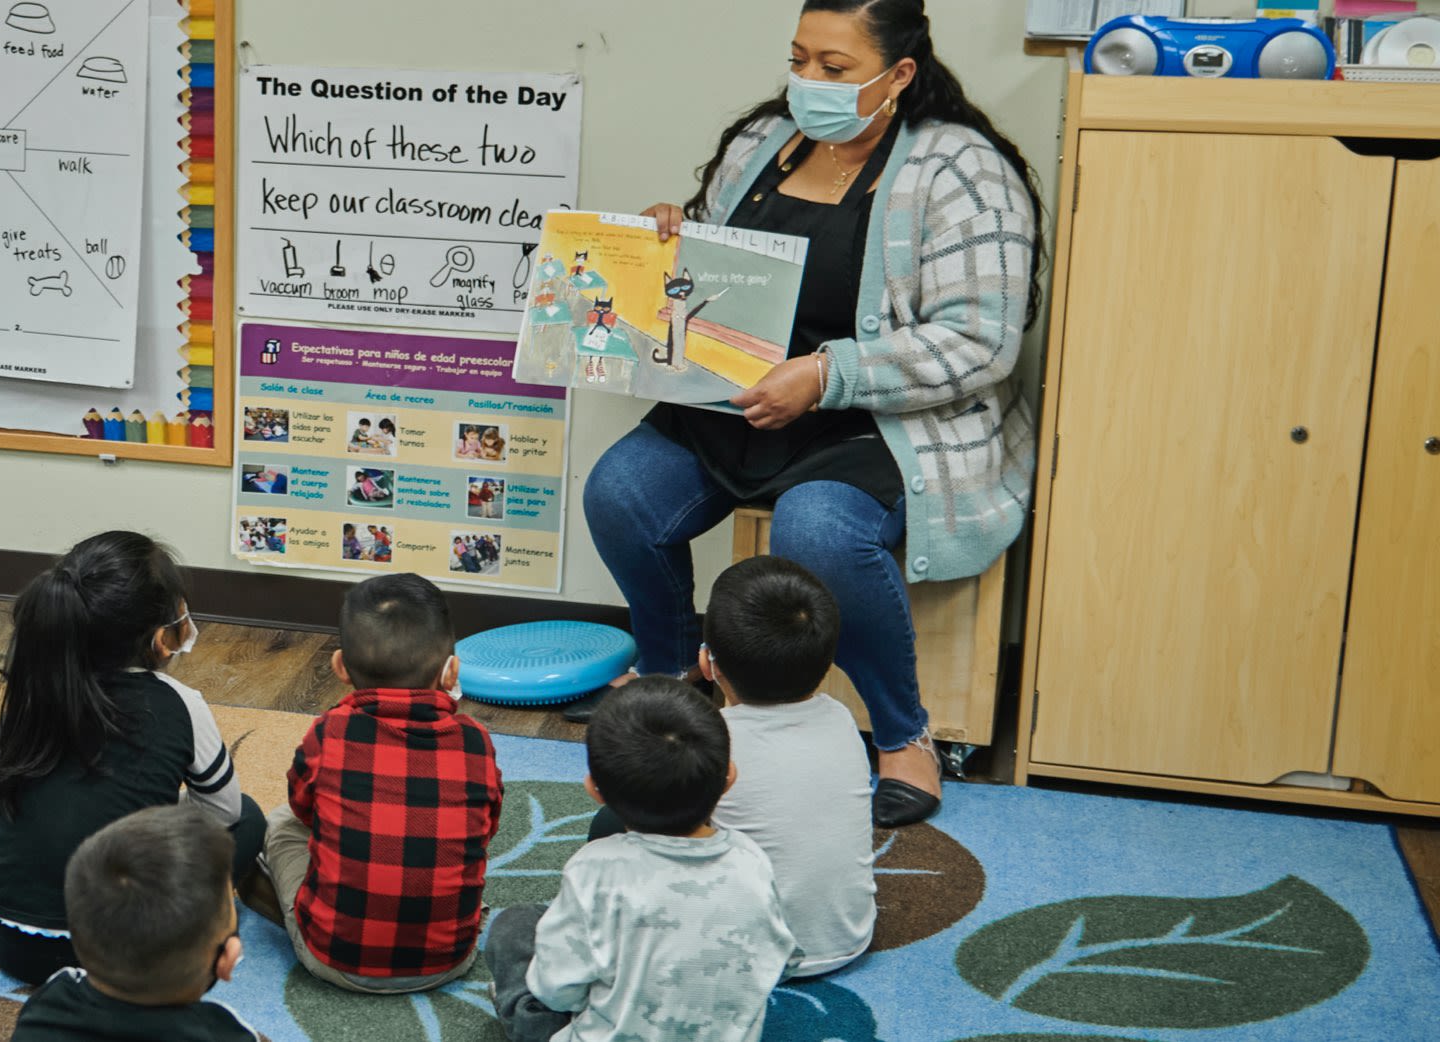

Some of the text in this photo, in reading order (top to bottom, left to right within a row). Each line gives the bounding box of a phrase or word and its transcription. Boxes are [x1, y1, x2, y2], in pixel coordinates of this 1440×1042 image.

[3, 41, 64, 58] feed food
[82, 85, 120, 99] water
[256, 76, 566, 111] The Question of the Day
[264, 113, 536, 166] Which of these two
[329, 193, 370, 214] our
[375, 187, 491, 225] classroom
[499, 198, 543, 230] clea
[2, 229, 26, 249] give
[731, 229, 738, 240] K
[750, 234, 758, 246] L
[773, 239, 786, 253] M
[13, 243, 62, 261] treats
[85, 238, 108, 254] ball
[452, 276, 496, 293] magnify
[324, 282, 359, 299] broom
[373, 286, 408, 304] mop
[456, 294, 494, 309] glass
[327, 303, 355, 311] PLEASE
[439, 310, 475, 318] MARKERS
[291, 342, 514, 368] Expectativas para niños de edad preescolar
[14, 365, 47, 375] MARKERS
[316, 358, 353, 367] respetuoso
[362, 360, 401, 370] Mantenerse
[404, 364, 427, 373] seguro
[436, 365, 468, 376] Trabajar
[480, 369, 503, 378] equipo
[260, 383, 323, 396] Salón de clase
[365, 388, 435, 405] Área de recreo
[468, 399, 554, 414] Pasillos/Transición
[292, 411, 334, 422] Utilizar los
[314, 425, 331, 433] para
[400, 427, 425, 436] Tomar
[292, 434, 325, 444] escuchar
[399, 439, 425, 448] turnos
[511, 434, 538, 444] Hablar
[522, 447, 547, 457] gritar
[291, 466, 329, 477] Mantener
[301, 480, 328, 489] cuerpo
[398, 475, 441, 486] Mantenerse
[290, 489, 324, 500] relajado
[397, 487, 450, 498] sentado sobre
[507, 484, 555, 496] Utilizar los
[507, 497, 546, 507] pies para
[506, 508, 540, 518] caminar
[289, 527, 318, 537] Ayudar
[288, 538, 330, 549] los amigos
[397, 541, 437, 552] Compartir
[505, 545, 554, 558] Mantenerse
[504, 557, 531, 567] juntos
